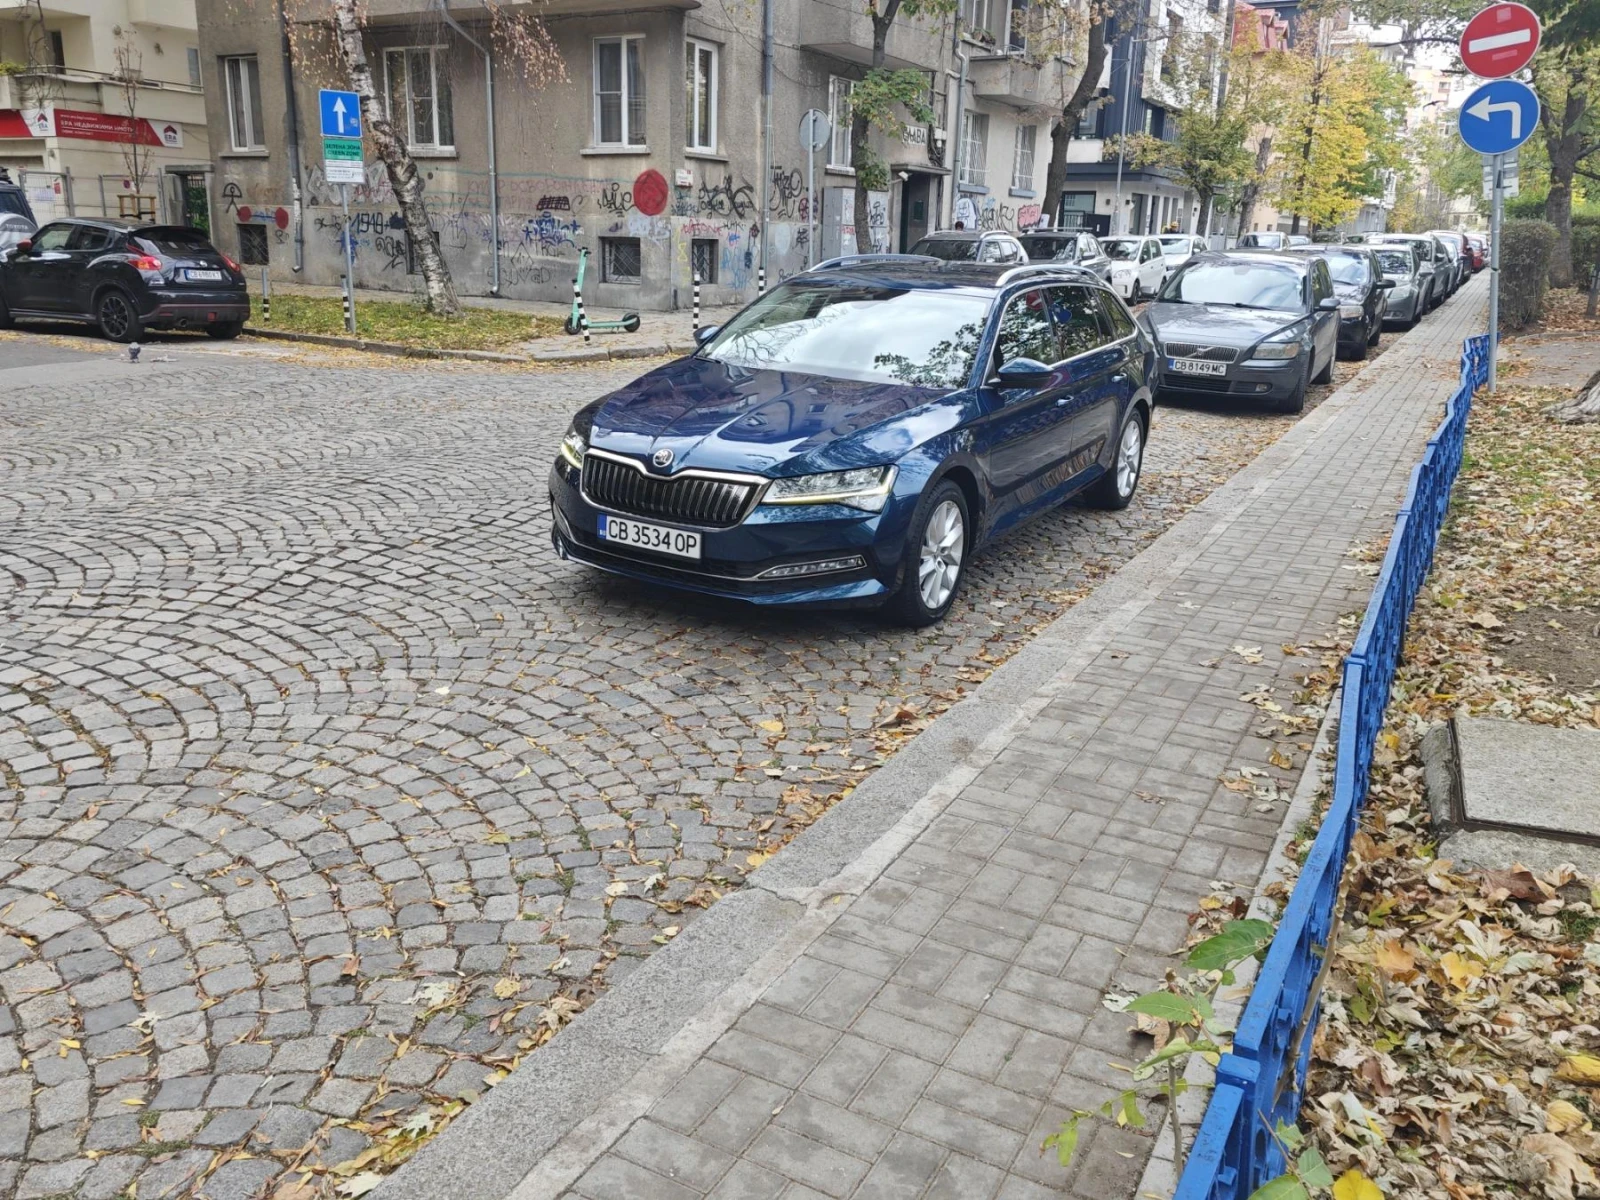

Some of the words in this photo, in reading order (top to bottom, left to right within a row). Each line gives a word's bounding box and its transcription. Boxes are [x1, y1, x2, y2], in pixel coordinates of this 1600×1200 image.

[1175, 360, 1187, 371] CB
[1188, 362, 1210, 372] 8149
[1211, 363, 1225, 374] MC
[608, 519, 629, 541] CB
[631, 524, 671, 550] 3534
[674, 533, 697, 554] OP
